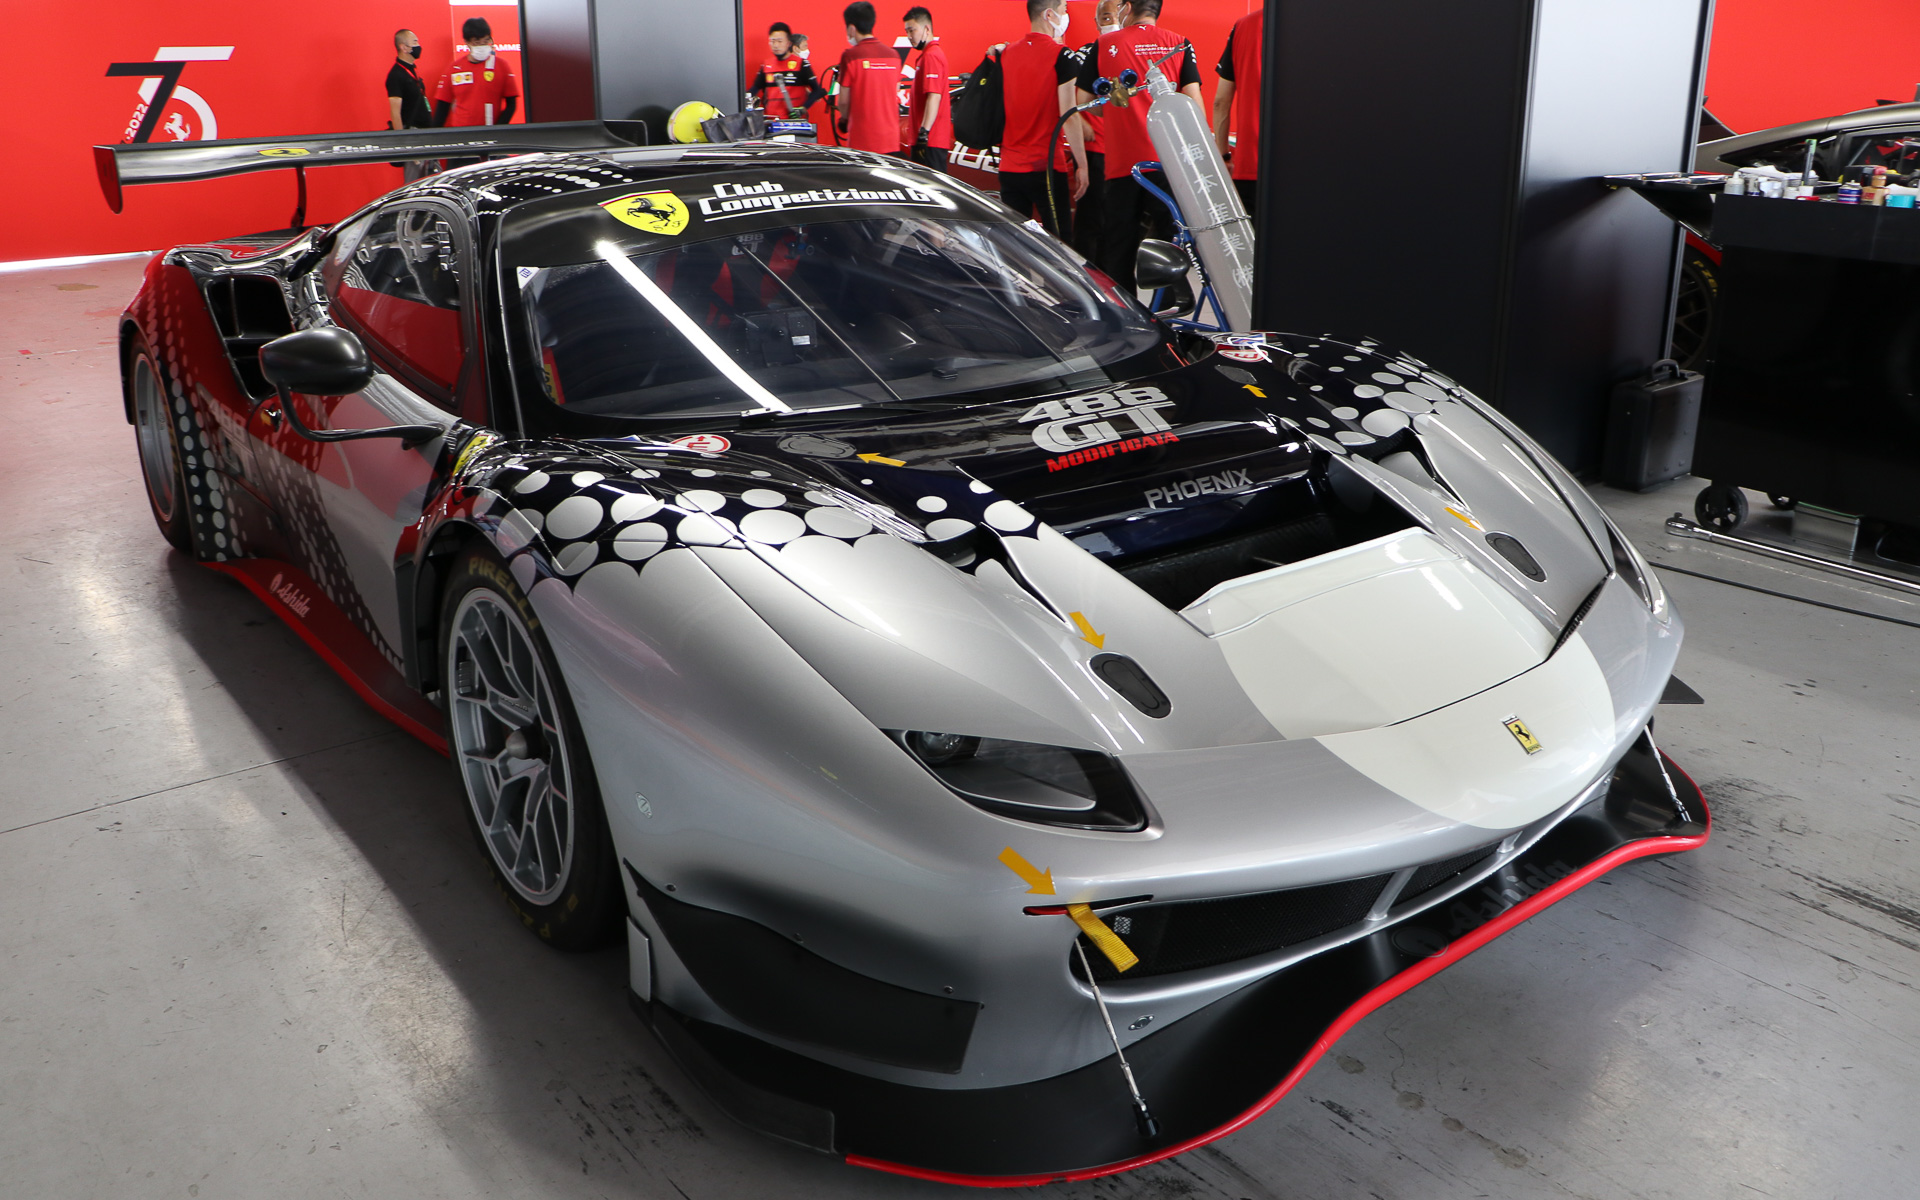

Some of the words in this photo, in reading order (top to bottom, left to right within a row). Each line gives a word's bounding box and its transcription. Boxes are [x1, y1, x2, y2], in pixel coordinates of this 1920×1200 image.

[698, 188, 907, 215] Competizioni
[713, 181, 784, 199] Club
[1018, 386, 1169, 424] 488
[1031, 401, 1177, 453] GT
[1045, 431, 1181, 473] MODIFICATA
[1143, 467, 1254, 510] PHOENIX
[468, 556, 540, 630] PIRELLI
